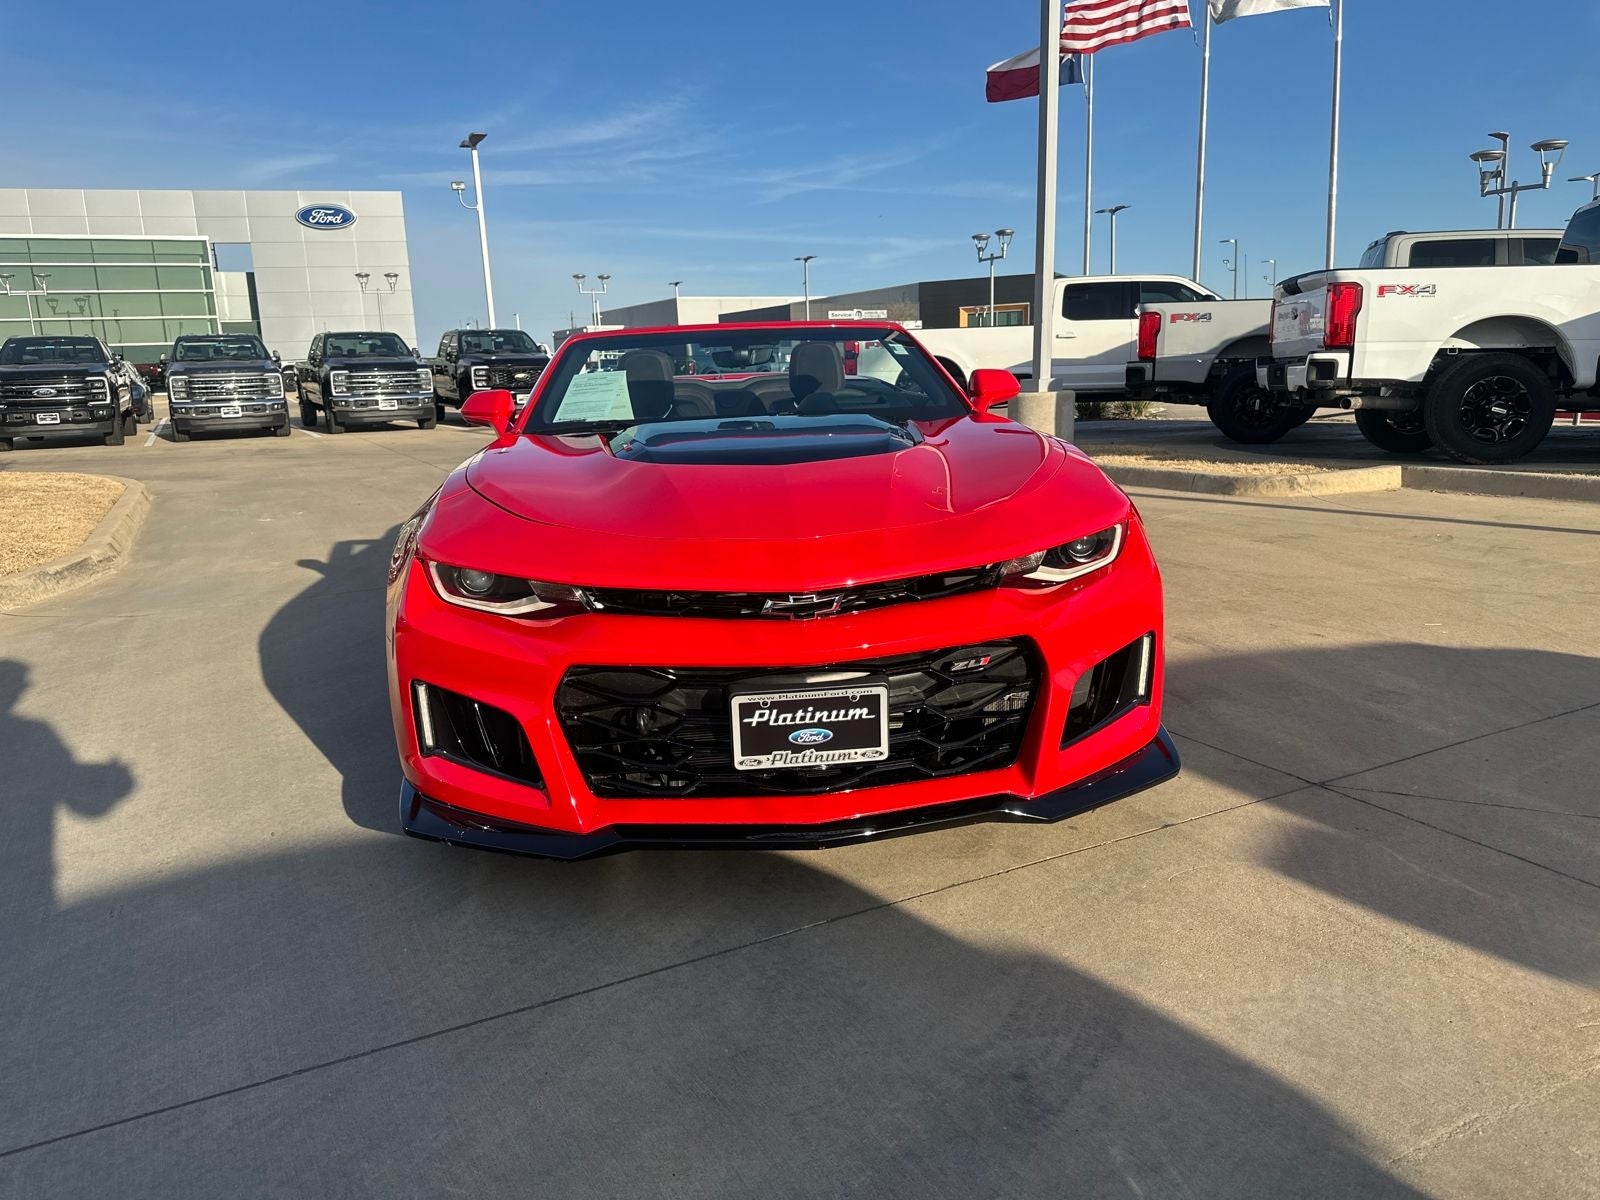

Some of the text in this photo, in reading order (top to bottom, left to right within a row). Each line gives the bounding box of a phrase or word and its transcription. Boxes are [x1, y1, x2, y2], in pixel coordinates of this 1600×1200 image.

[309, 209, 343, 223] Ford
[1376, 284, 1436, 297] FX4
[1170, 312, 1212, 323] FX4
[951, 656, 991, 671] ZL1
[747, 689, 873, 702] www.PlatinumFord.com
[743, 706, 876, 727] Platinum
[797, 730, 824, 742] Ford
[771, 749, 857, 766] Platinum
